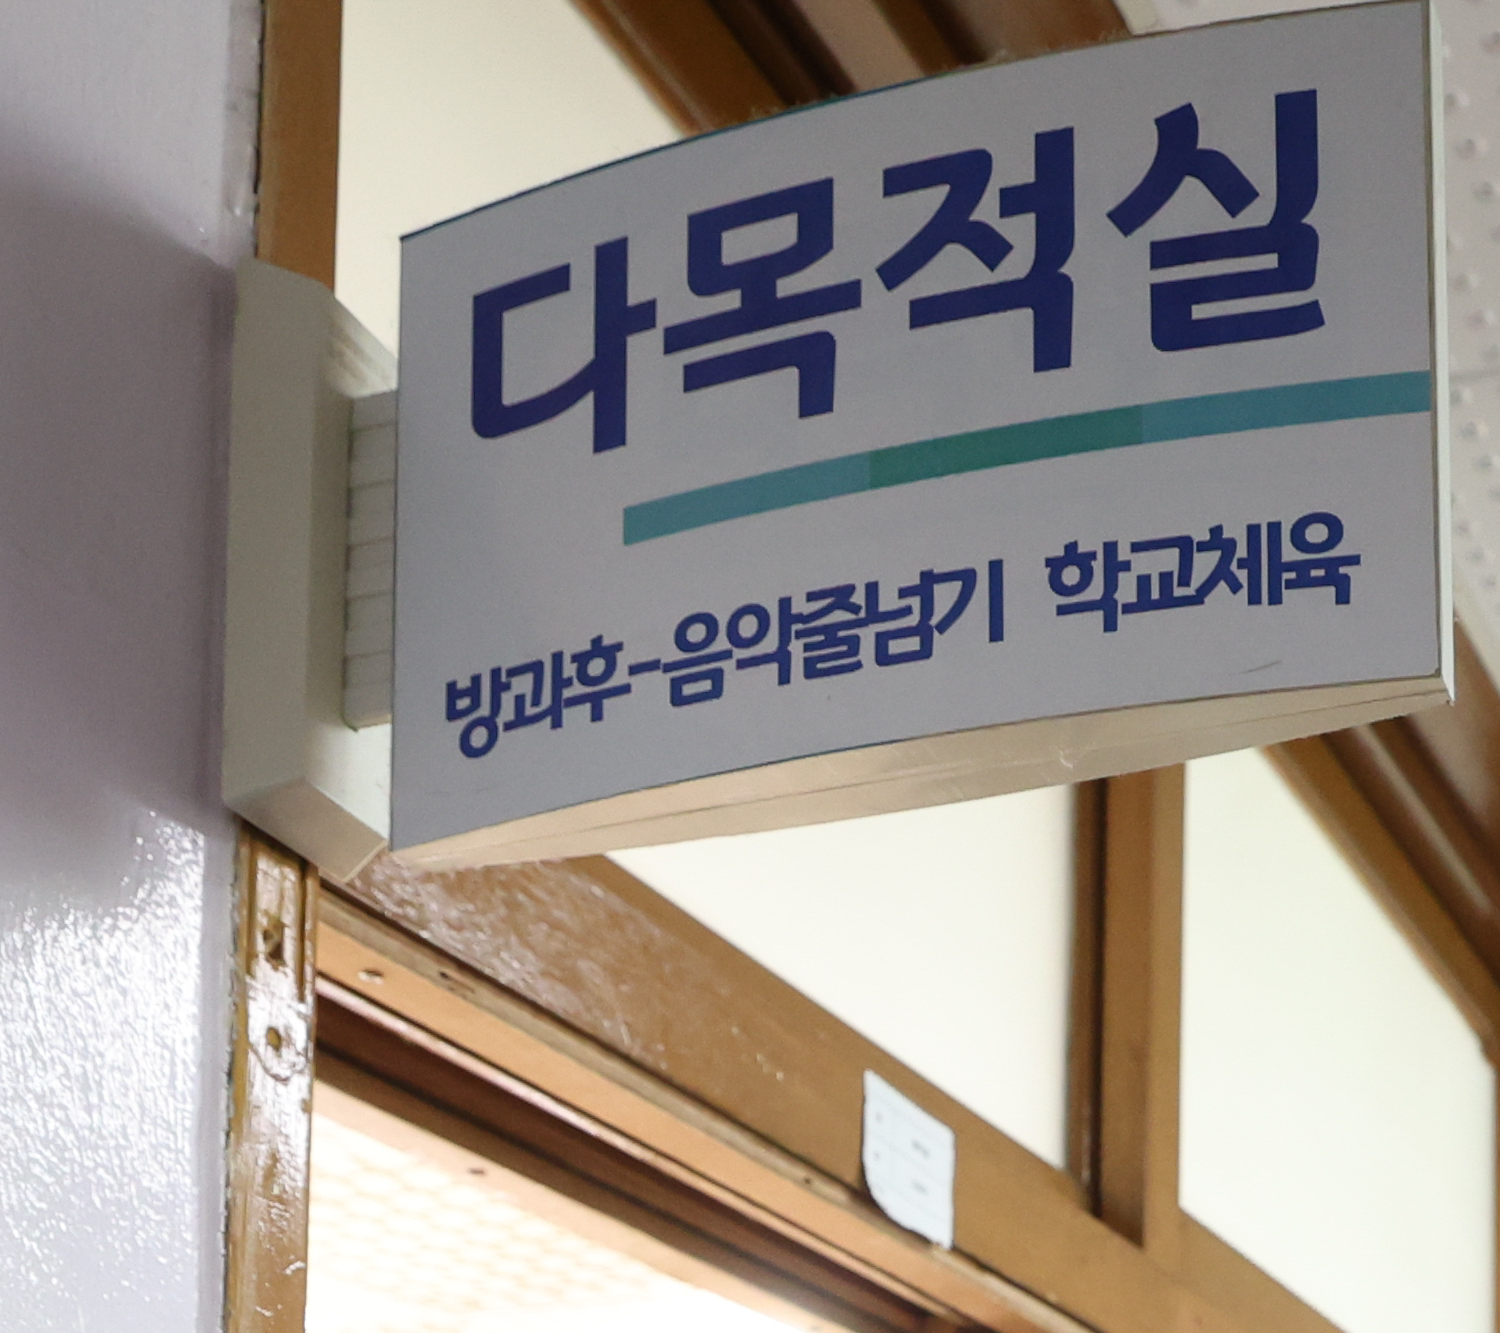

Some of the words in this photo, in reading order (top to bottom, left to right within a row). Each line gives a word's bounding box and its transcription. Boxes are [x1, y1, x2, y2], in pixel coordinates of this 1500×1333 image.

[472, 89, 1325, 453] 다목적실
[446, 559, 1004, 758] 방과후-음악줄넘기
[1045, 512, 1361, 633] 학교체육
